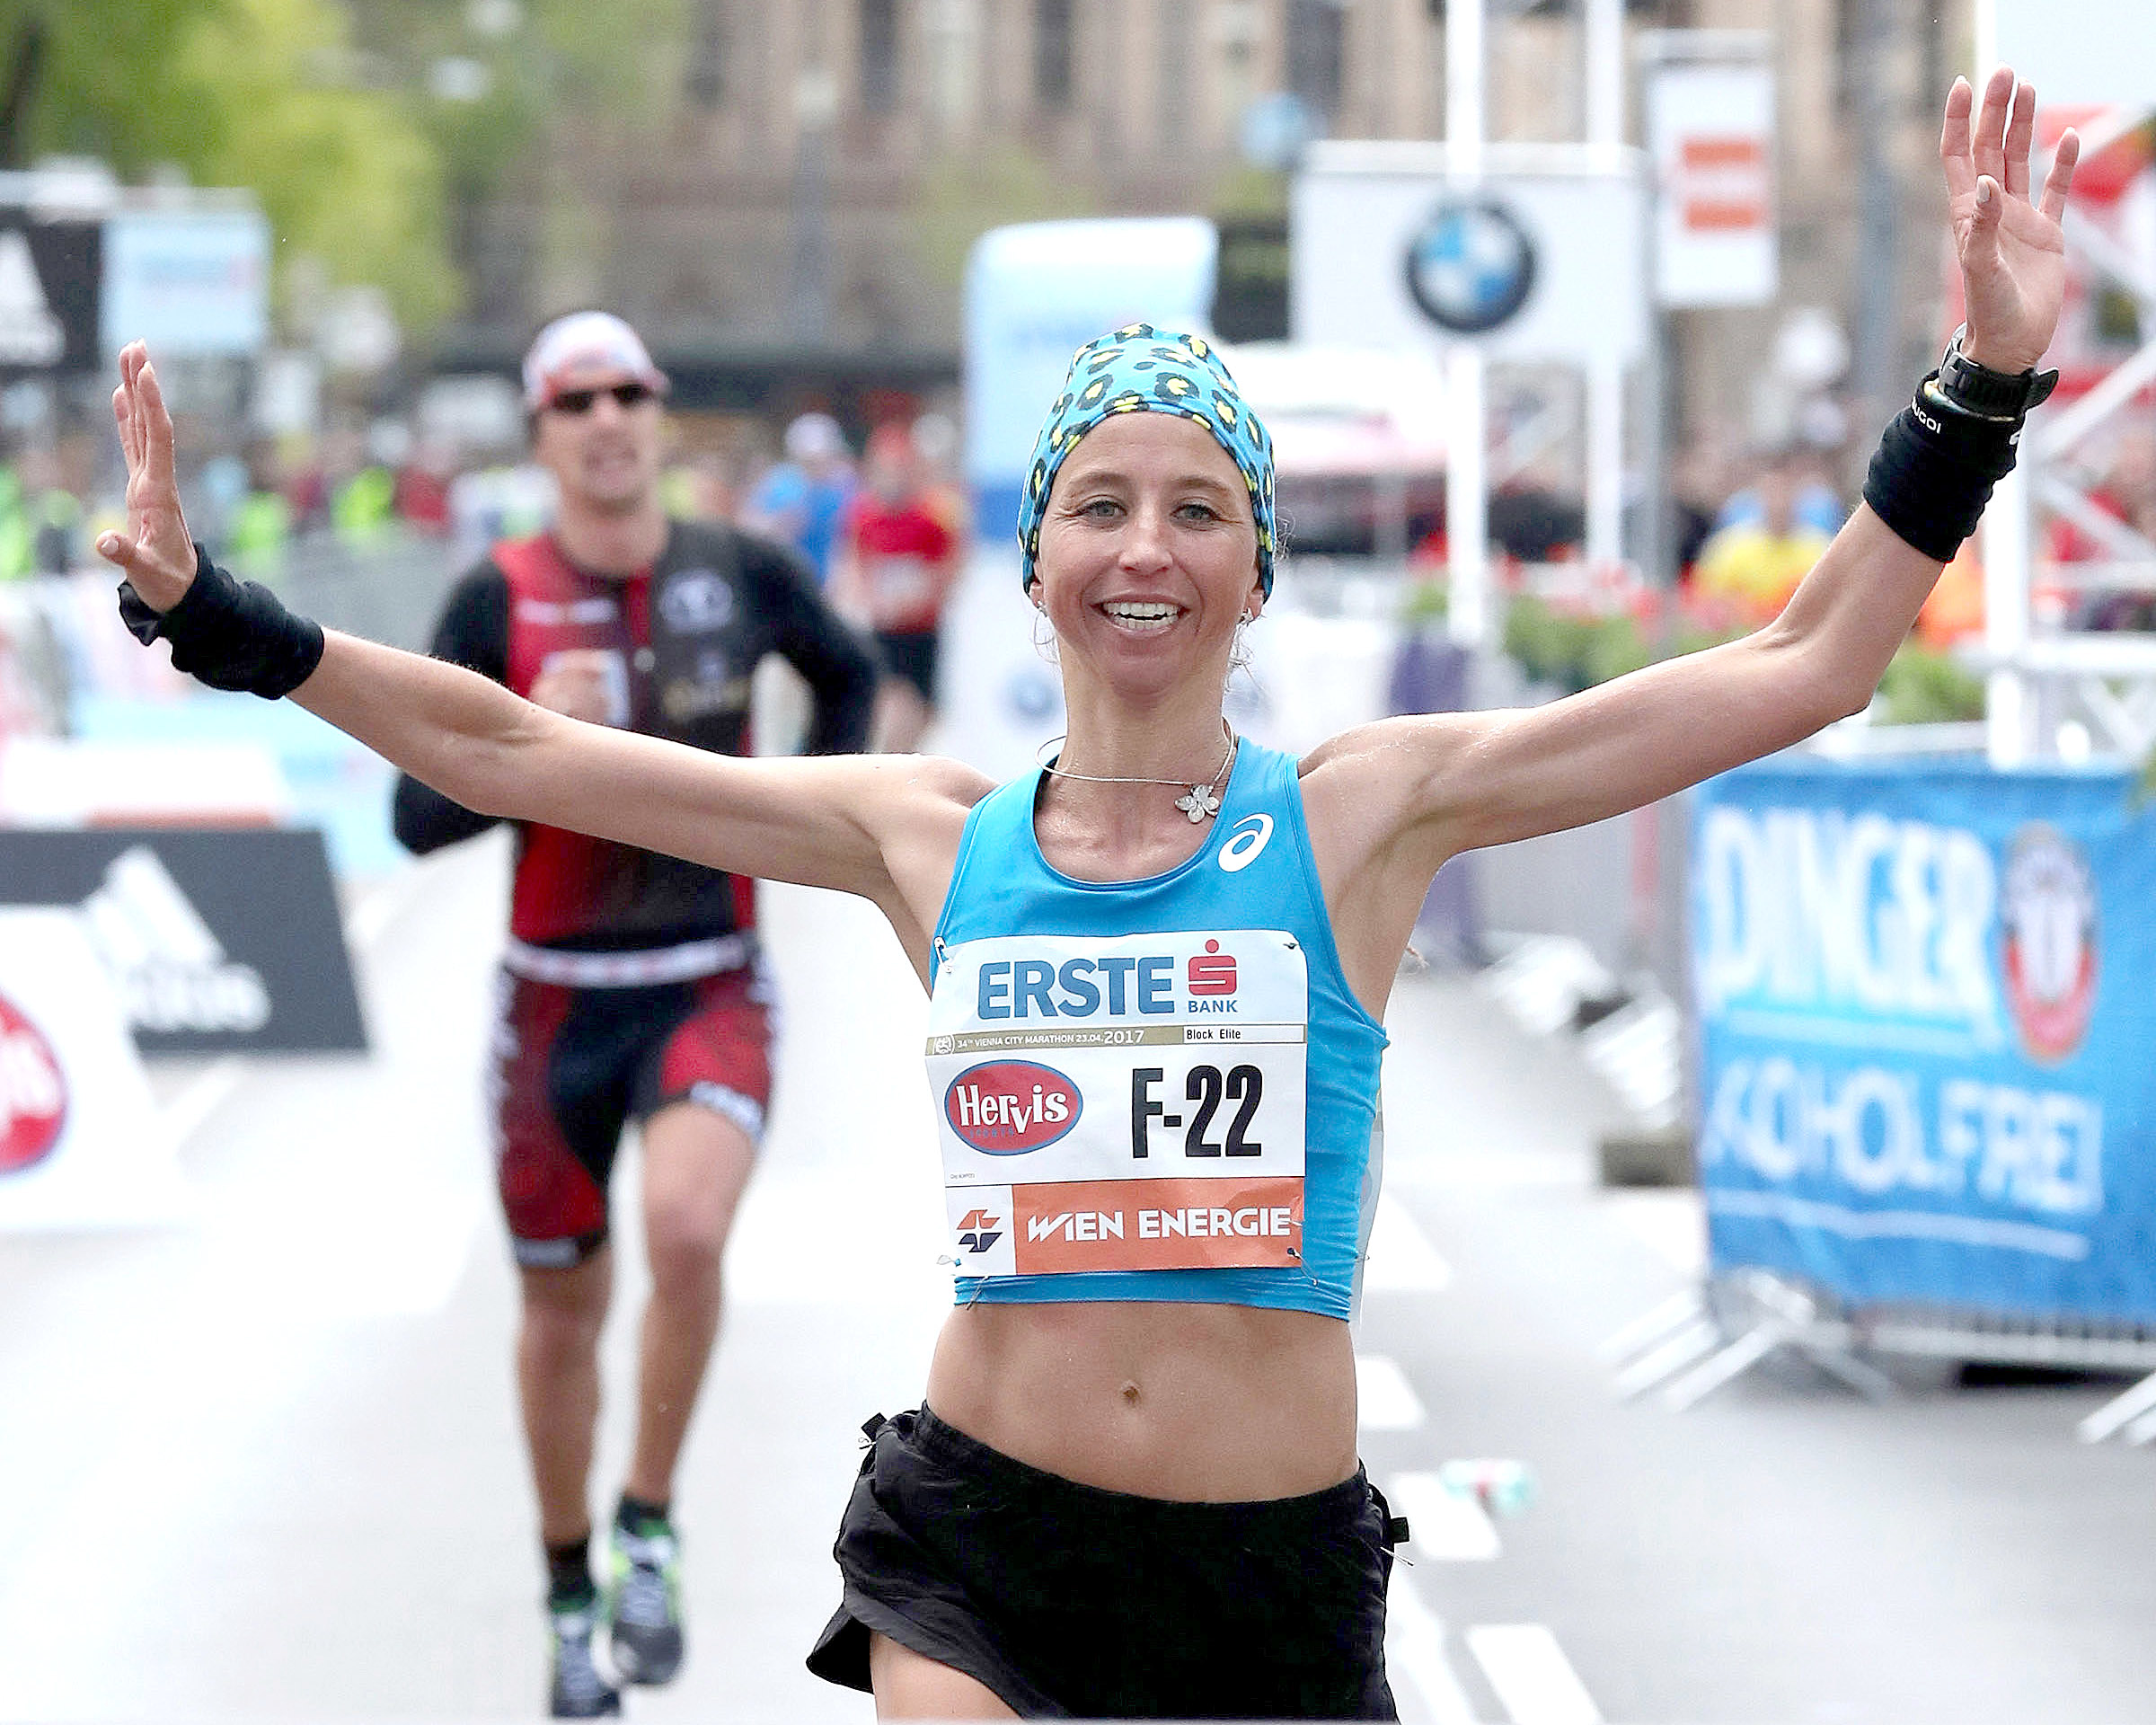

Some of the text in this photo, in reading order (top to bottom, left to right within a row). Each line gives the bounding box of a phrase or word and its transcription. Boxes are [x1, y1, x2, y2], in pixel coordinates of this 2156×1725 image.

[977, 957, 1174, 1020] ERSTE
[1188, 1000, 1238, 1013] BANK
[975, 1037, 1003, 1047] VIENNA
[1004, 1036, 1023, 1045] CITY
[1025, 1033, 1074, 1045] MARATHON
[1186, 1029, 1241, 1039] Block Elite
[955, 1084, 1069, 1134] Hervis
[1132, 1065, 1263, 1158] F-22
[1027, 1208, 1292, 1243] WIEN ENERGIE
